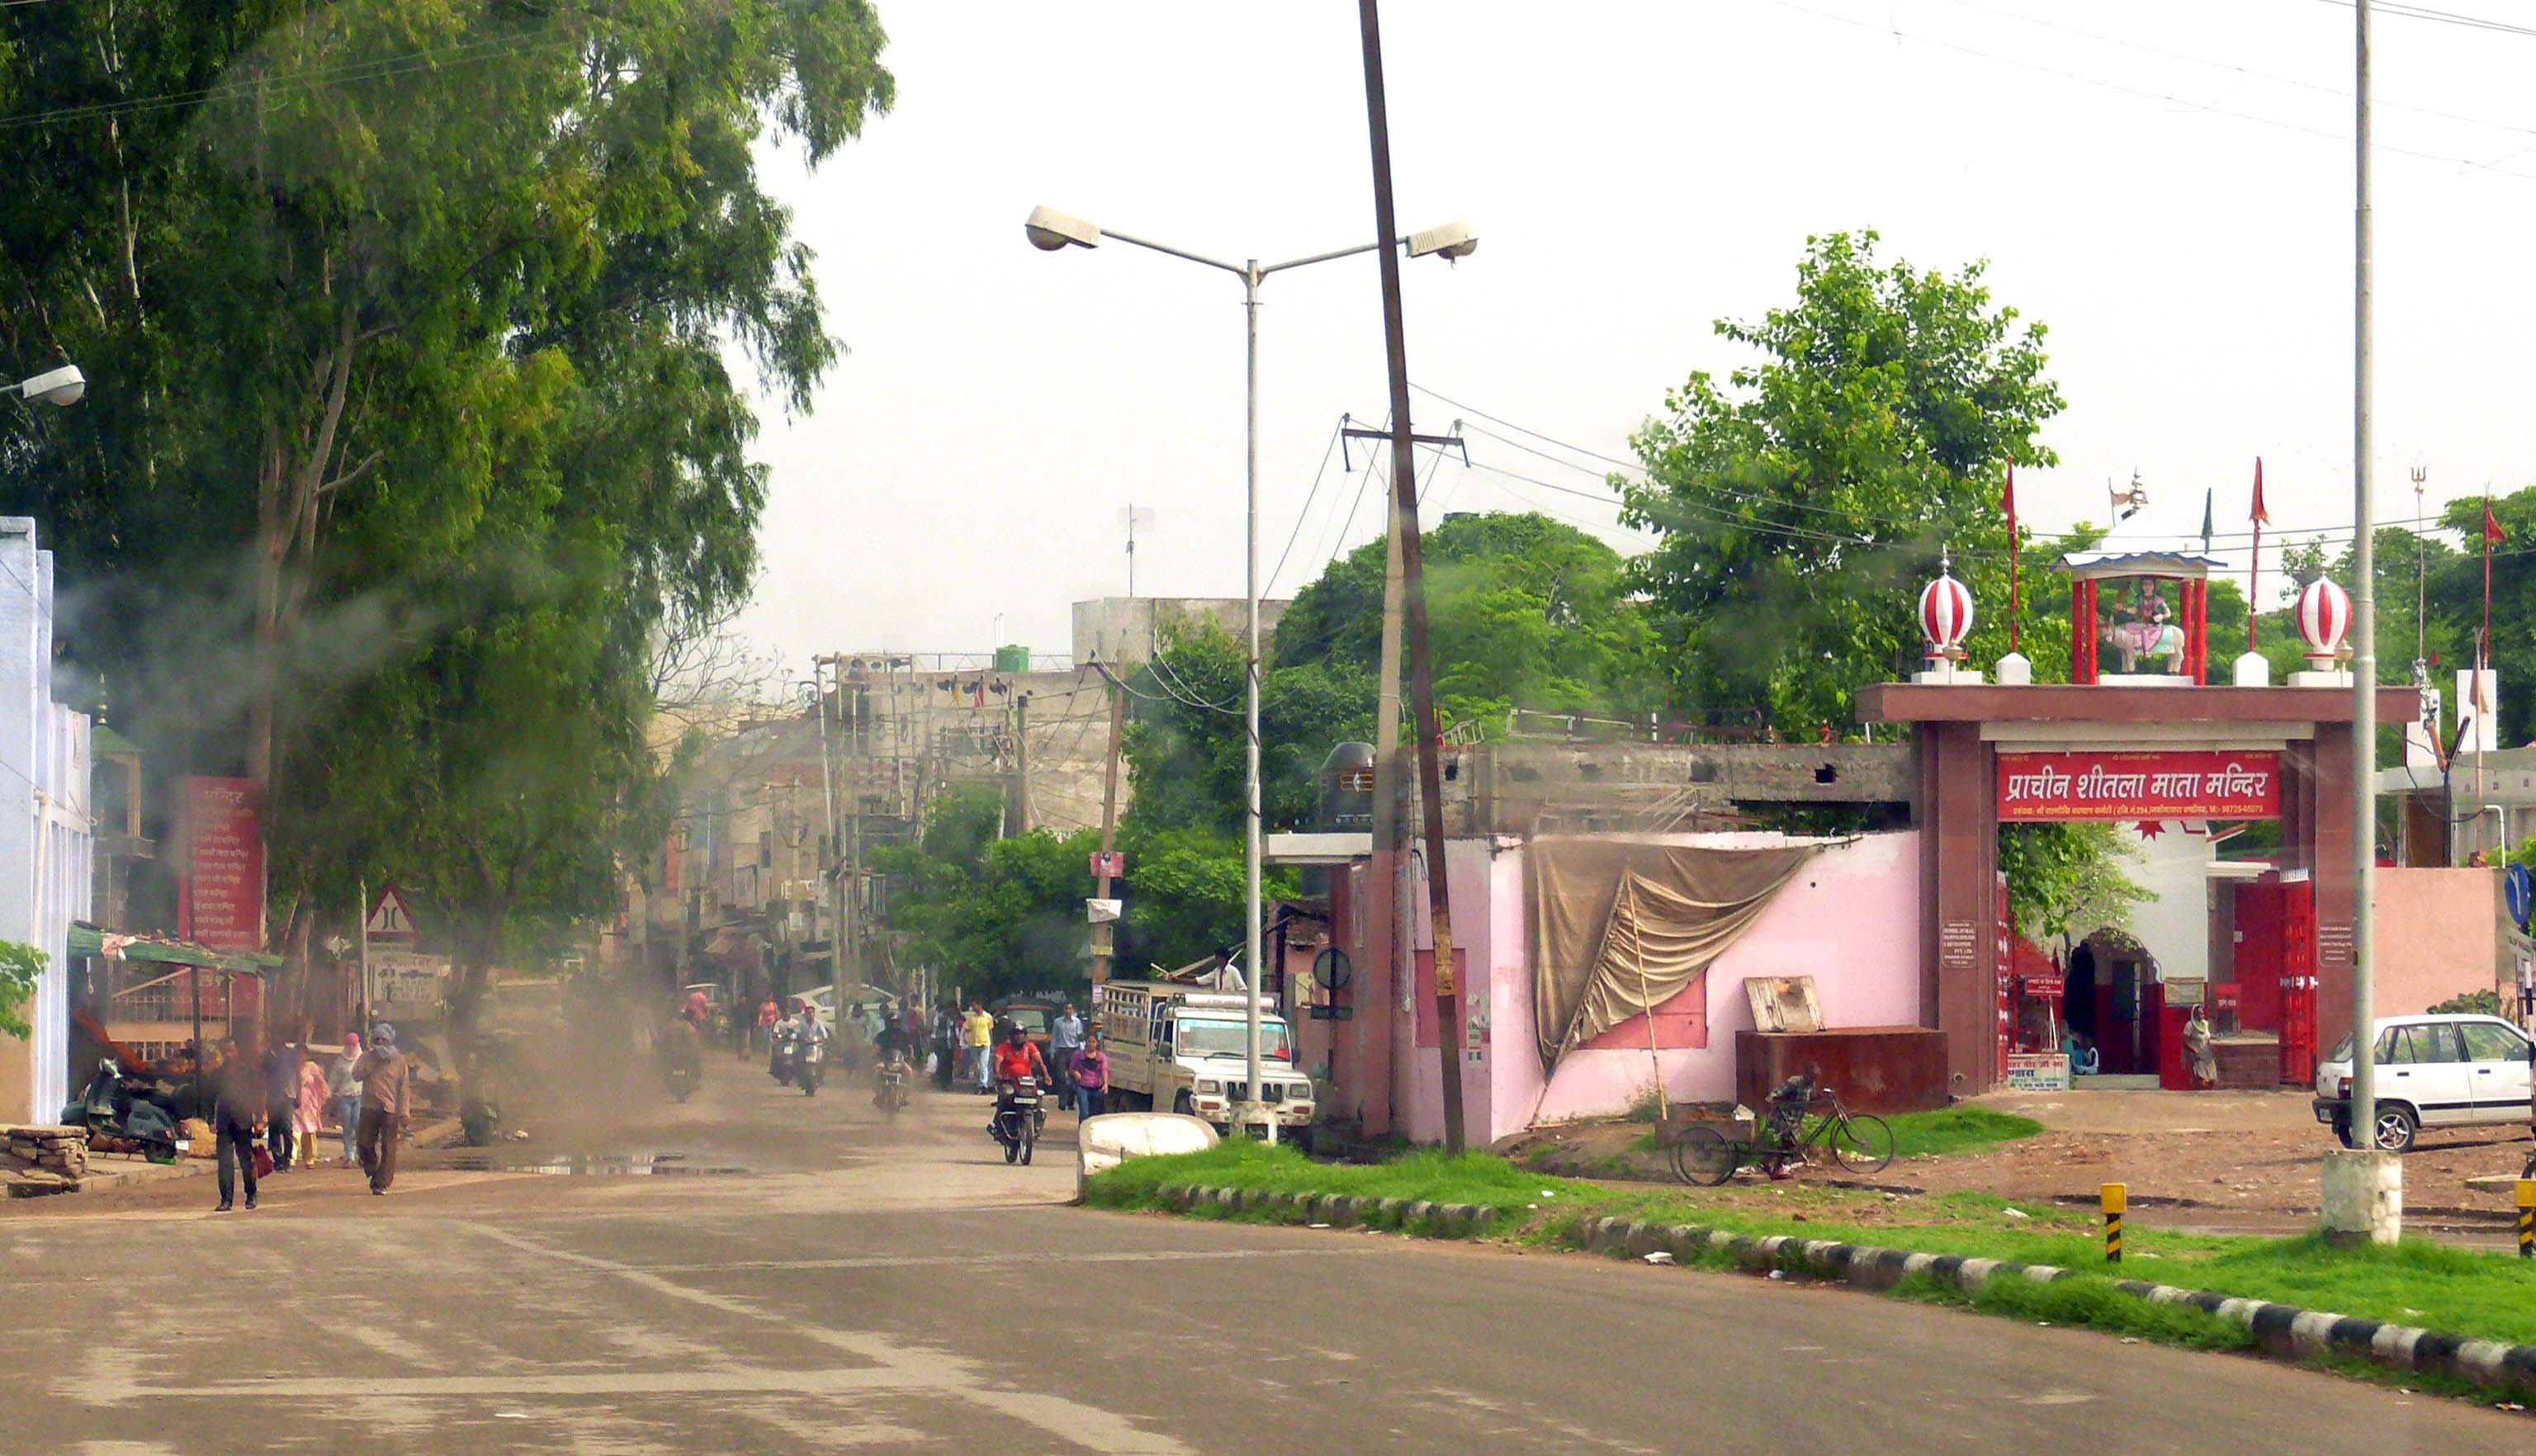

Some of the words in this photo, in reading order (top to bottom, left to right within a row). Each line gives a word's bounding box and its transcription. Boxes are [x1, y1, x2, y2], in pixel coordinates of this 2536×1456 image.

[2005, 763, 2071, 802] प्राचीन
[2076, 763, 2146, 799] शीतला
[2150, 773, 2202, 798] माता
[2205, 762, 2269, 798] मन्दिर
